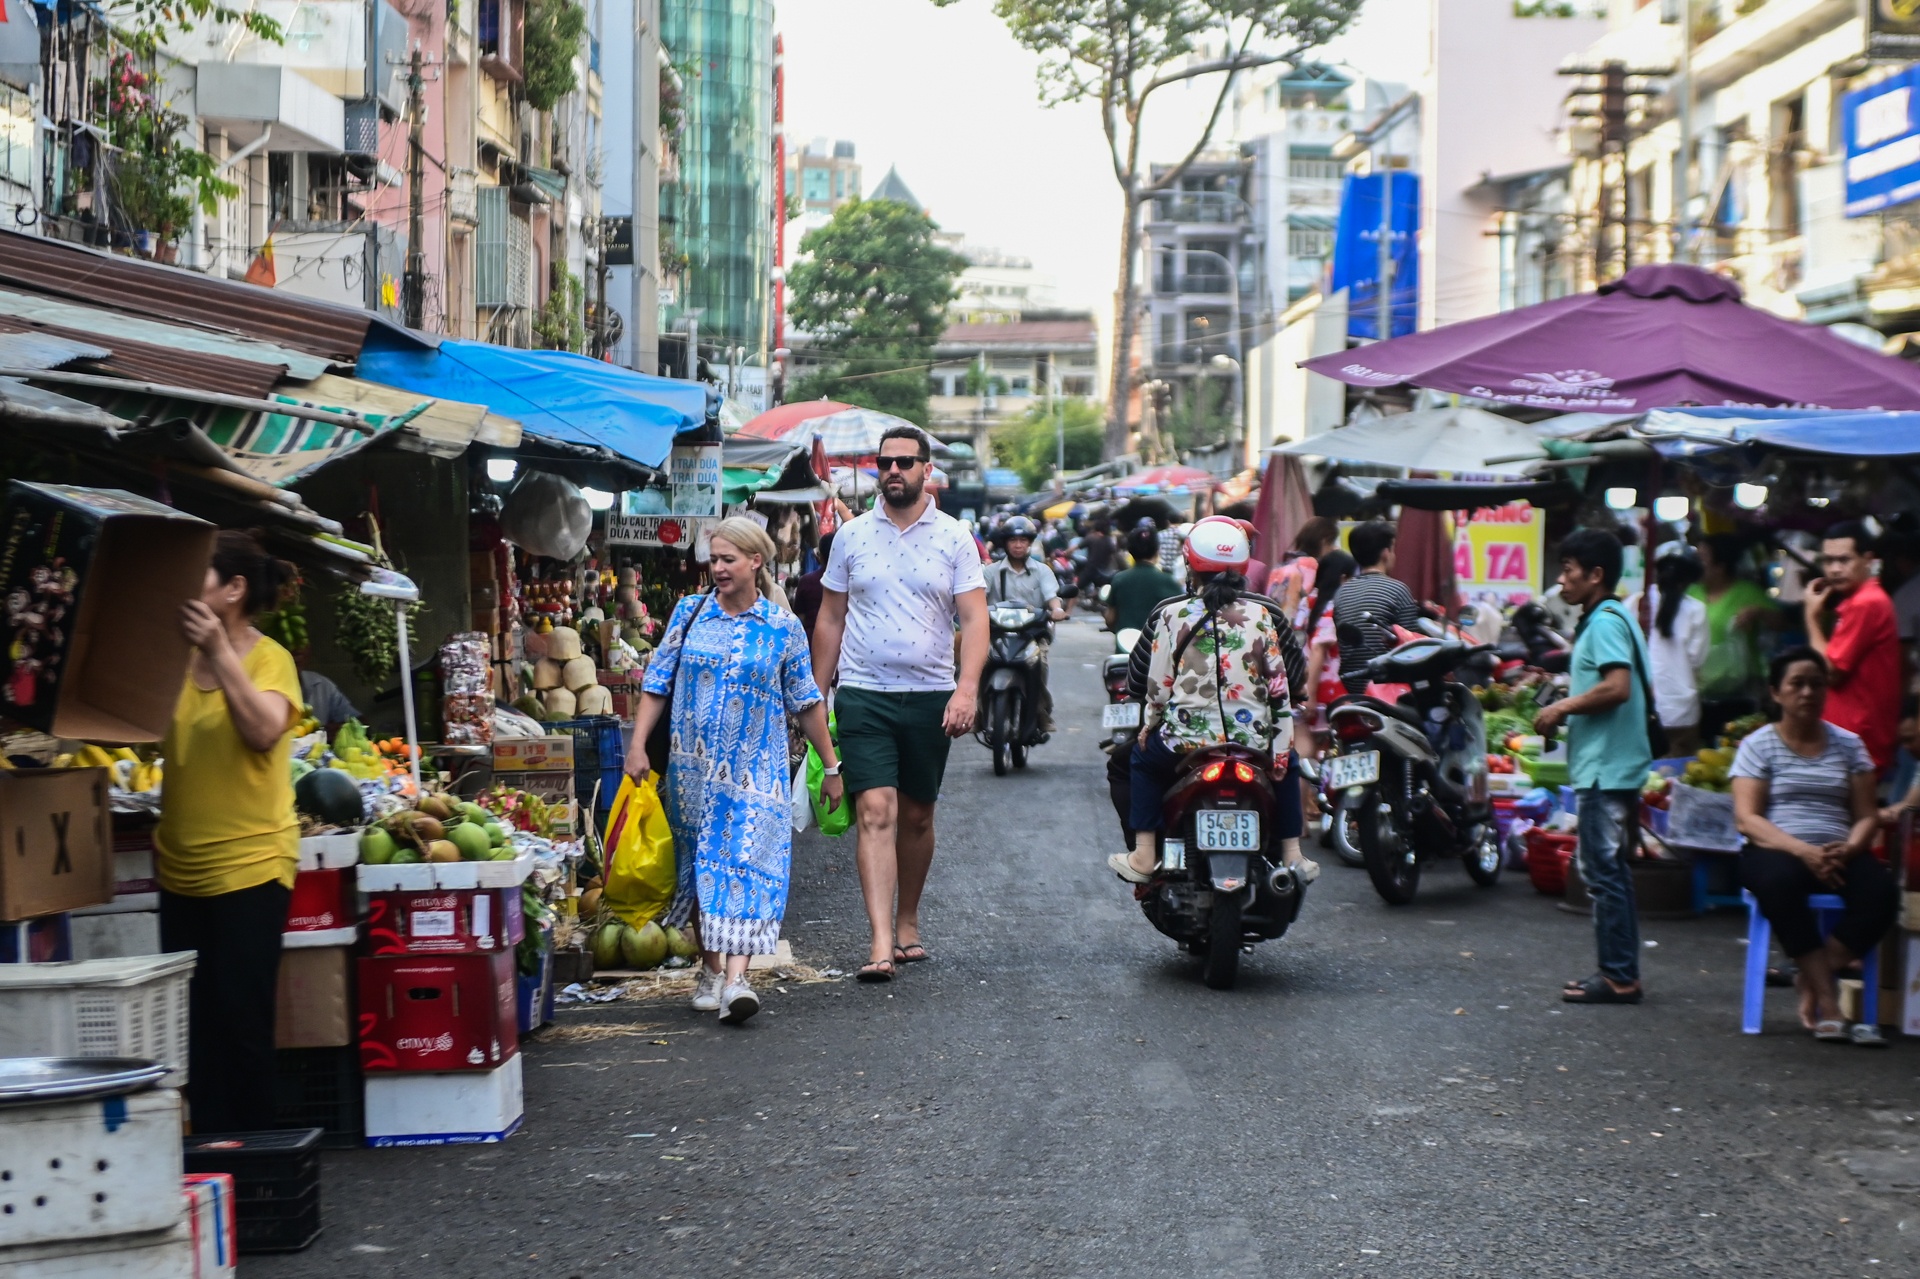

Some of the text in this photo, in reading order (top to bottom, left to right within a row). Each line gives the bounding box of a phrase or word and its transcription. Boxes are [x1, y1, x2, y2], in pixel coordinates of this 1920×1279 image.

[1216, 544, 1234, 552] CGV
[1486, 544, 1528, 580] TA
[605, 683, 642, 694] ERN
[1207, 831, 1250, 847] 6088
